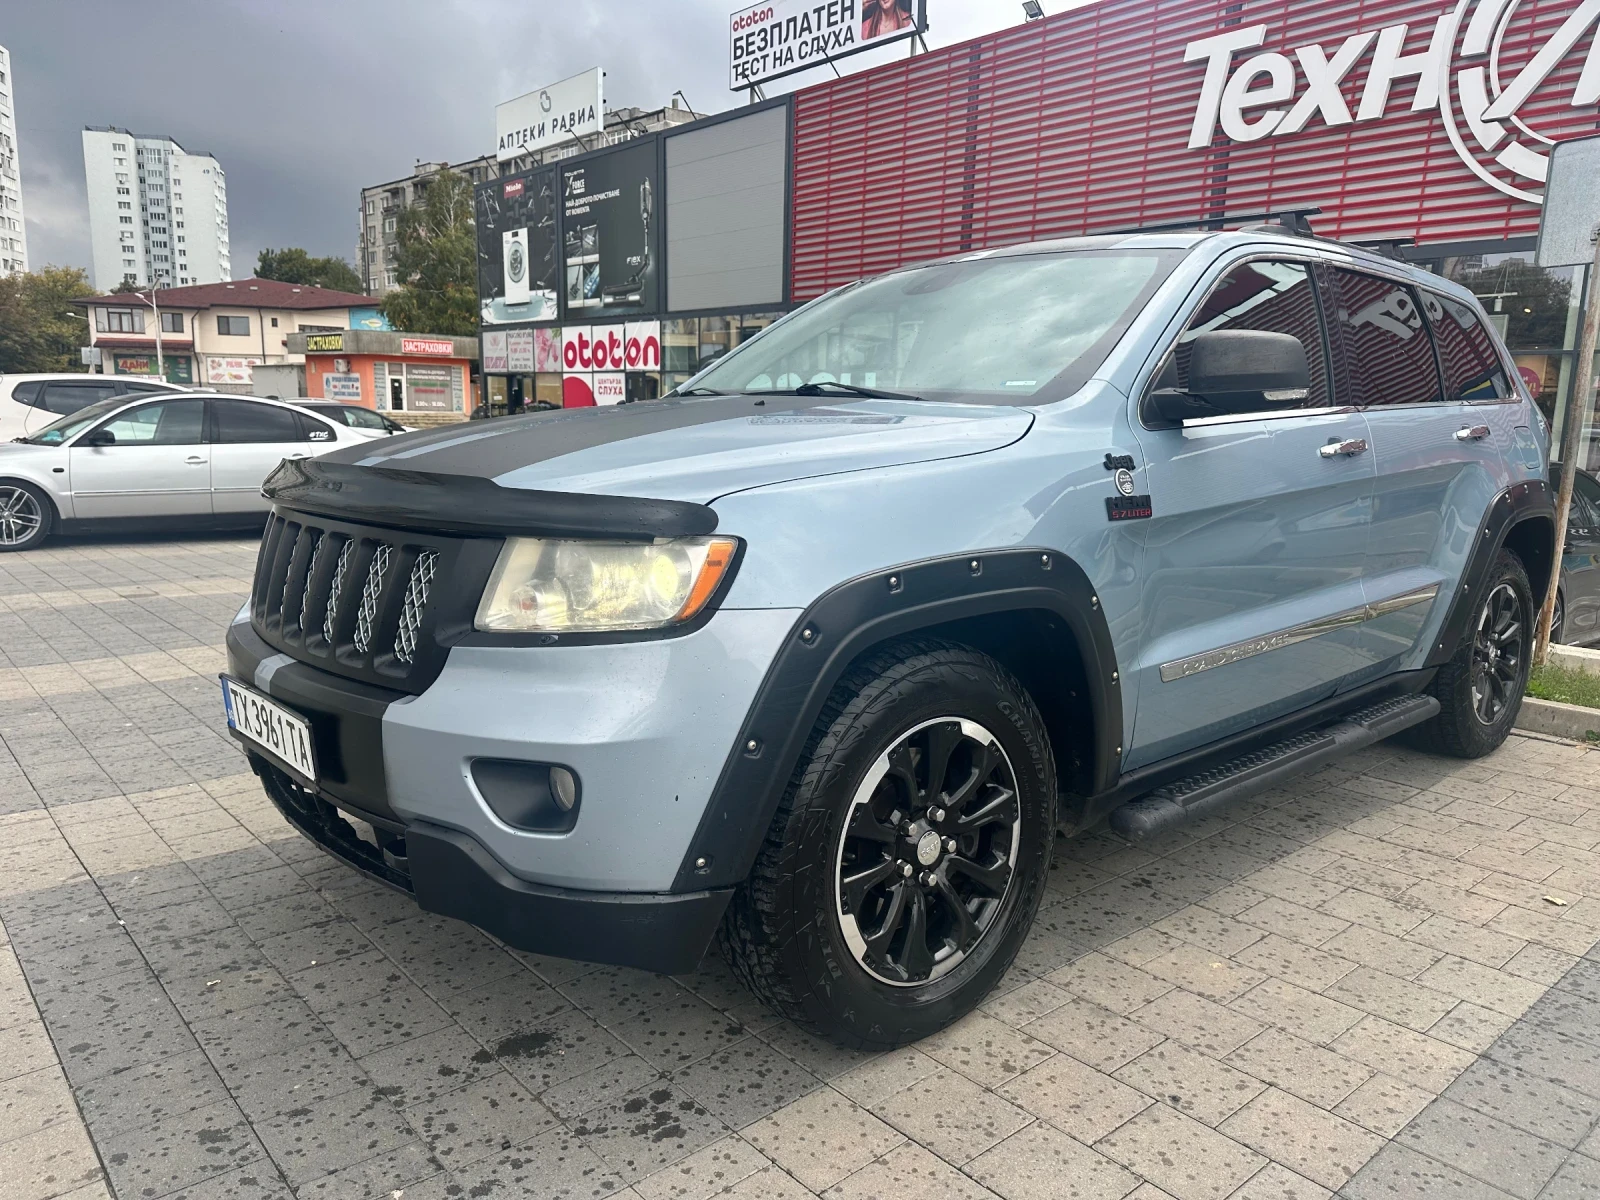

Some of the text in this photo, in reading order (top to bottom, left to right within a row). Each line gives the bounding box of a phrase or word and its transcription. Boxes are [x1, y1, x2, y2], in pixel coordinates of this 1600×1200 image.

[733, 7, 774, 32] ototon
[733, 0, 855, 61] БЕЗПЛАТЕН
[733, 25, 855, 82] ТЕСТ НА СЛУХА
[499, 104, 595, 151] АПТЕКИ РАВИА
[505, 182, 522, 193] Miele
[307, 335, 343, 351] ЗАСТРАХОВКИ
[404, 340, 453, 353] ЗАСТРАХОВКИ
[563, 330, 661, 369] ototon
[119, 359, 149, 371] ДАНИ
[598, 385, 623, 396] СЛУХА
[1103, 453, 1136, 471] Jeep
[1106, 495, 1152, 509] HEMI
[1127, 508, 1151, 517] LITER
[1182, 634, 1290, 676] GRAND CHEROKEE
